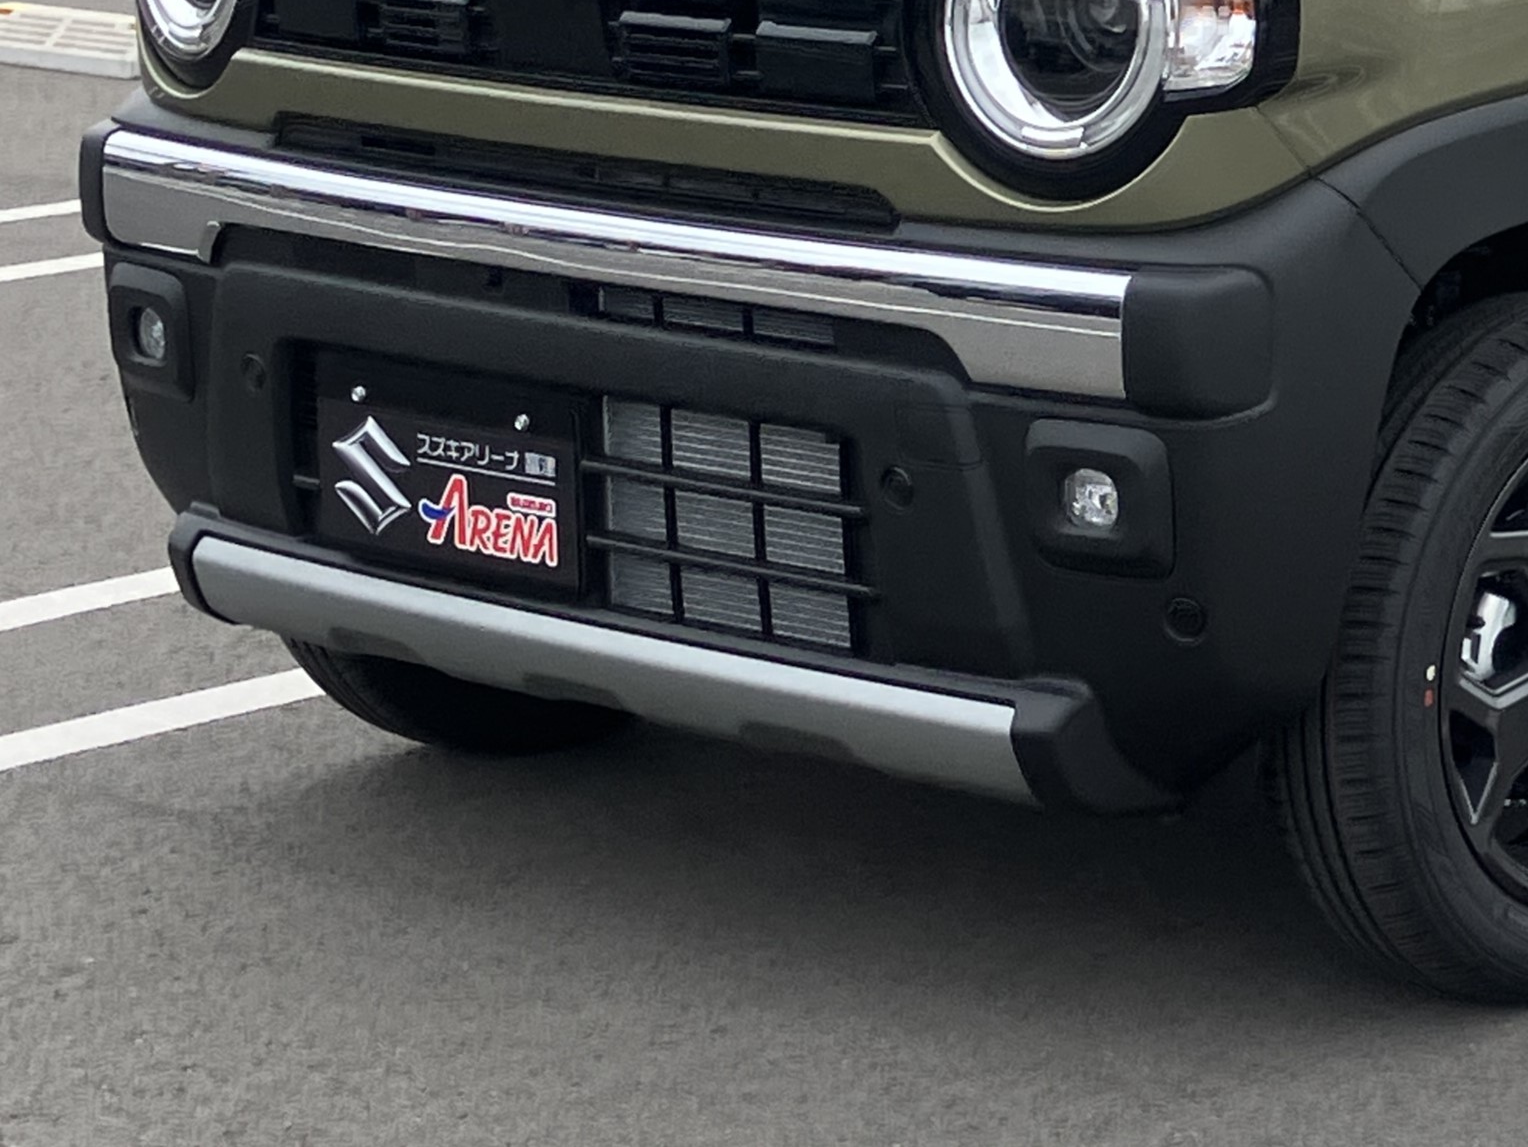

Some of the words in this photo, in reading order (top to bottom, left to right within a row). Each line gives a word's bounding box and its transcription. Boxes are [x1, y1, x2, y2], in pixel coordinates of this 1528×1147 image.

[416, 432, 520, 471] スズキアリーナ
[426, 473, 558, 567] ARENA
